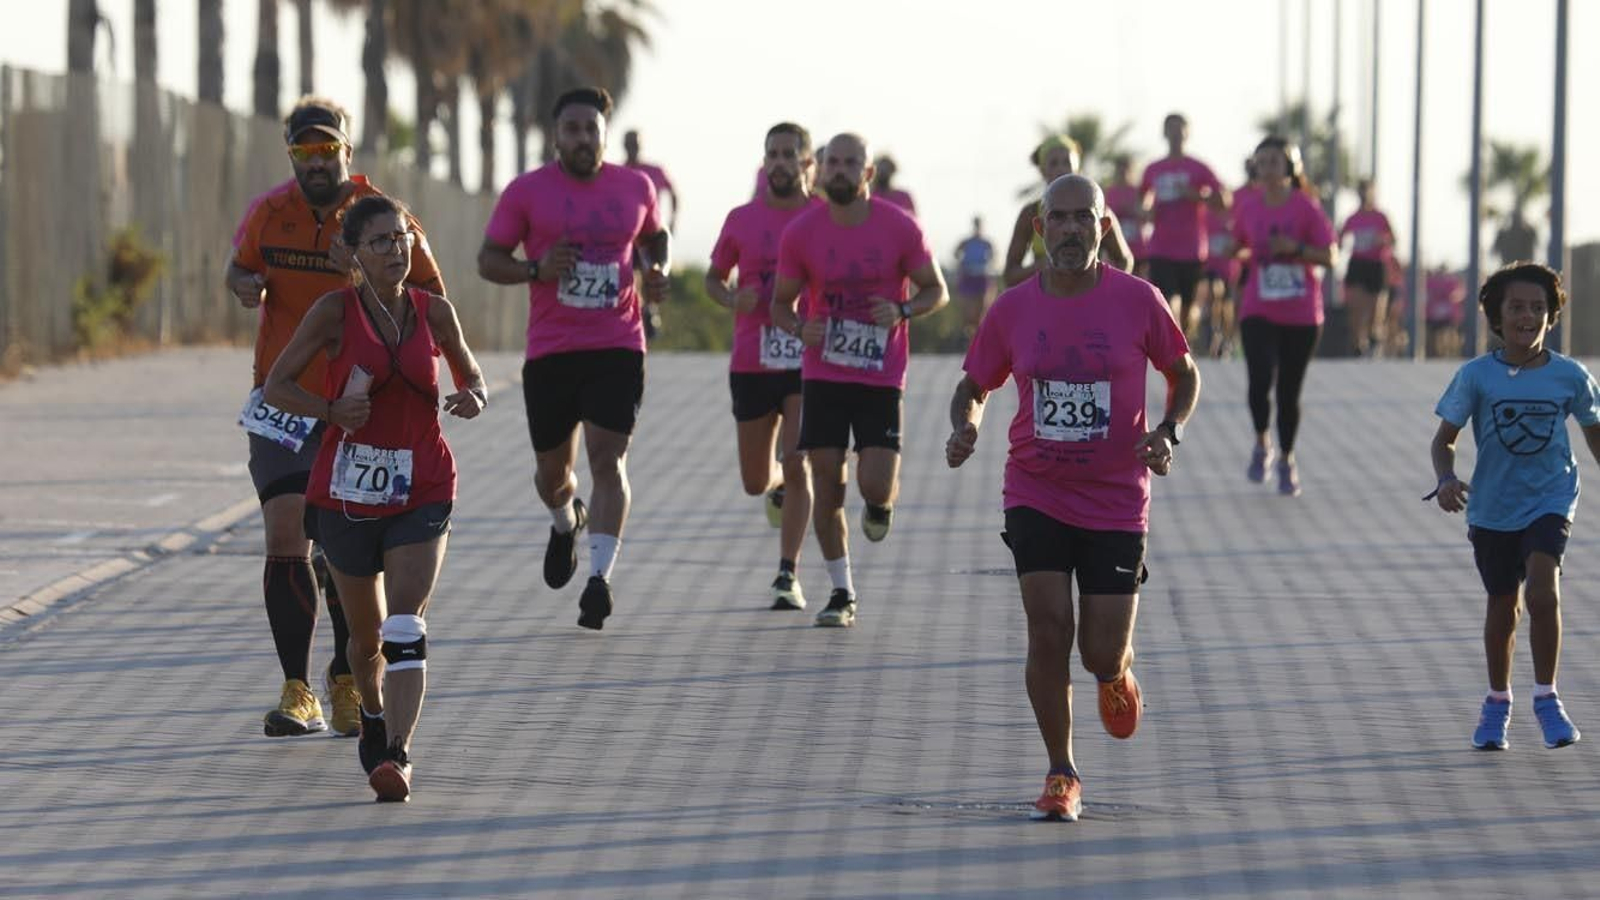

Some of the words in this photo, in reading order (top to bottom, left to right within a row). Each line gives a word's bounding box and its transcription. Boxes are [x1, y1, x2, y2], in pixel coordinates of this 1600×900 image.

[567, 276, 611, 298] 274
[833, 334, 876, 360] 246
[253, 402, 299, 434] 546
[1043, 400, 1097, 427] 239
[355, 463, 390, 493] 70
